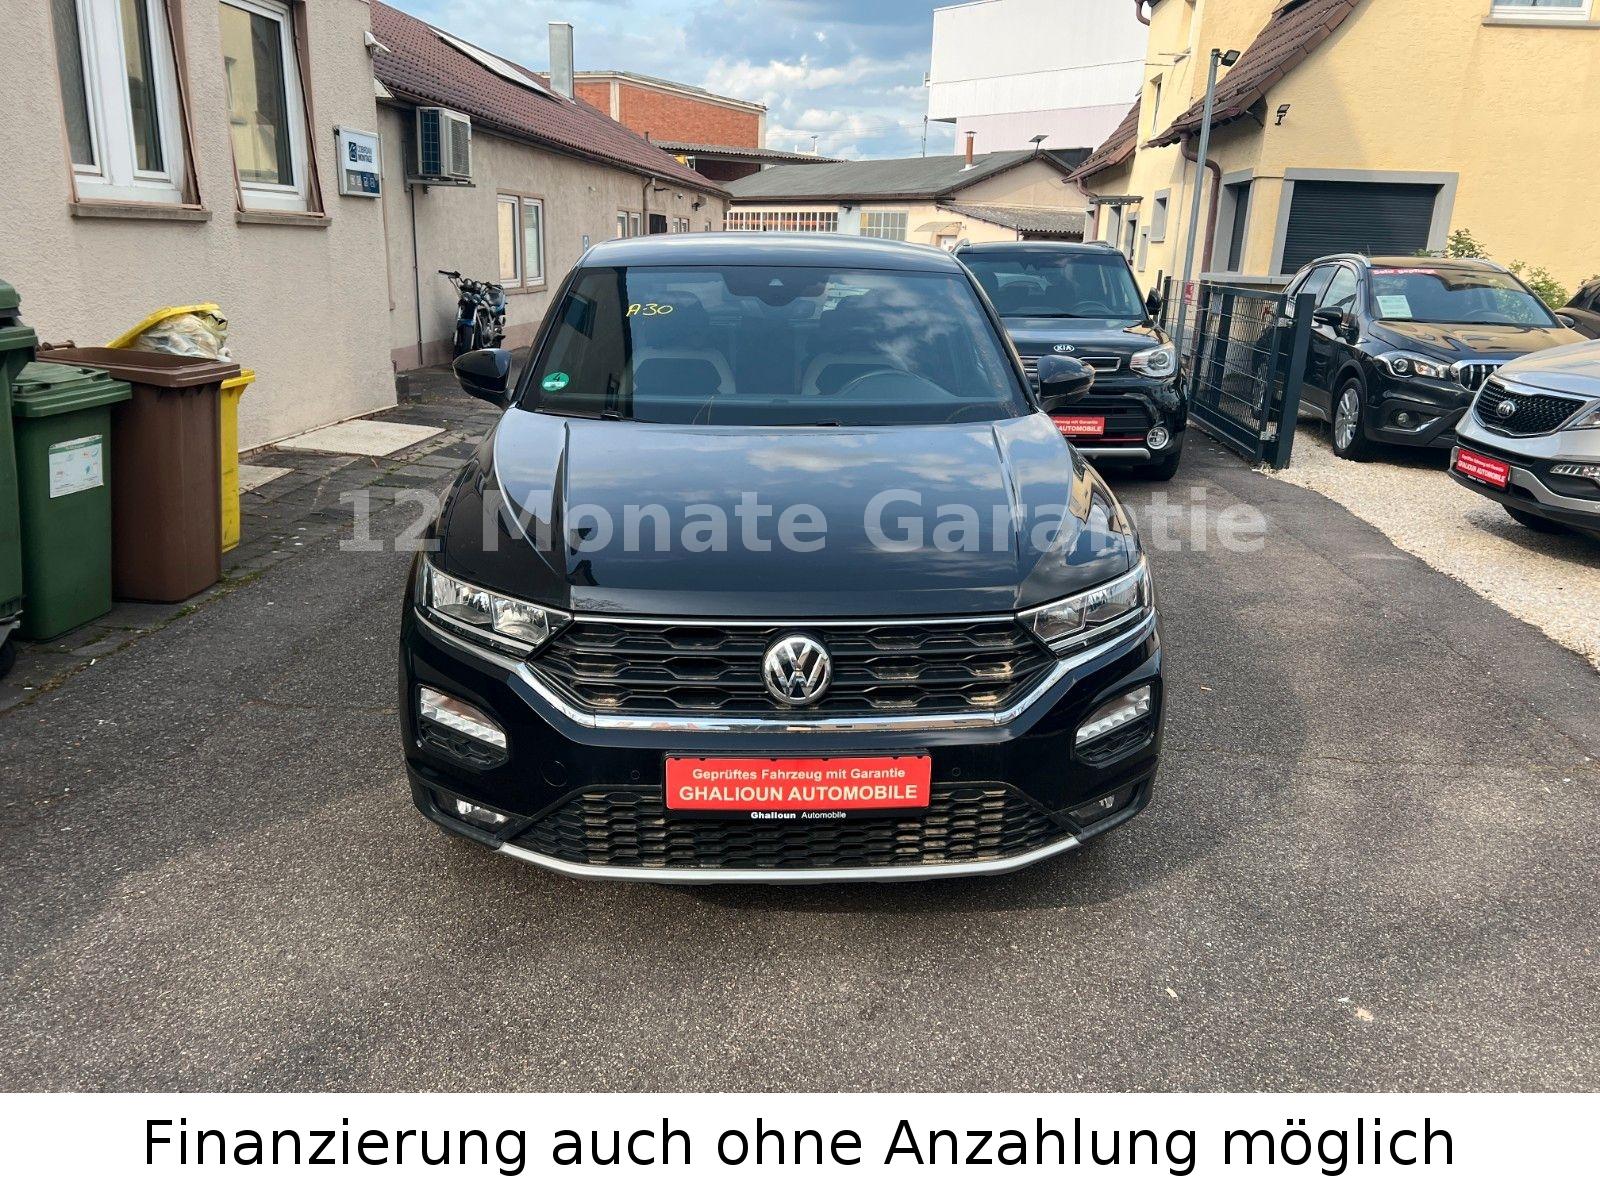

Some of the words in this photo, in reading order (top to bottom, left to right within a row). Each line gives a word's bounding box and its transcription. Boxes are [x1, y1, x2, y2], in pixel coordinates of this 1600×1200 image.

[692, 768, 757, 781] Geprüftes
[761, 769, 823, 782] Fahrzeug
[826, 768, 847, 780] mit
[850, 767, 906, 780] Garantie
[679, 785, 784, 801] GHALIOUN
[787, 785, 918, 801] AUTOMOBILE
[801, 811, 847, 820] Automobile
